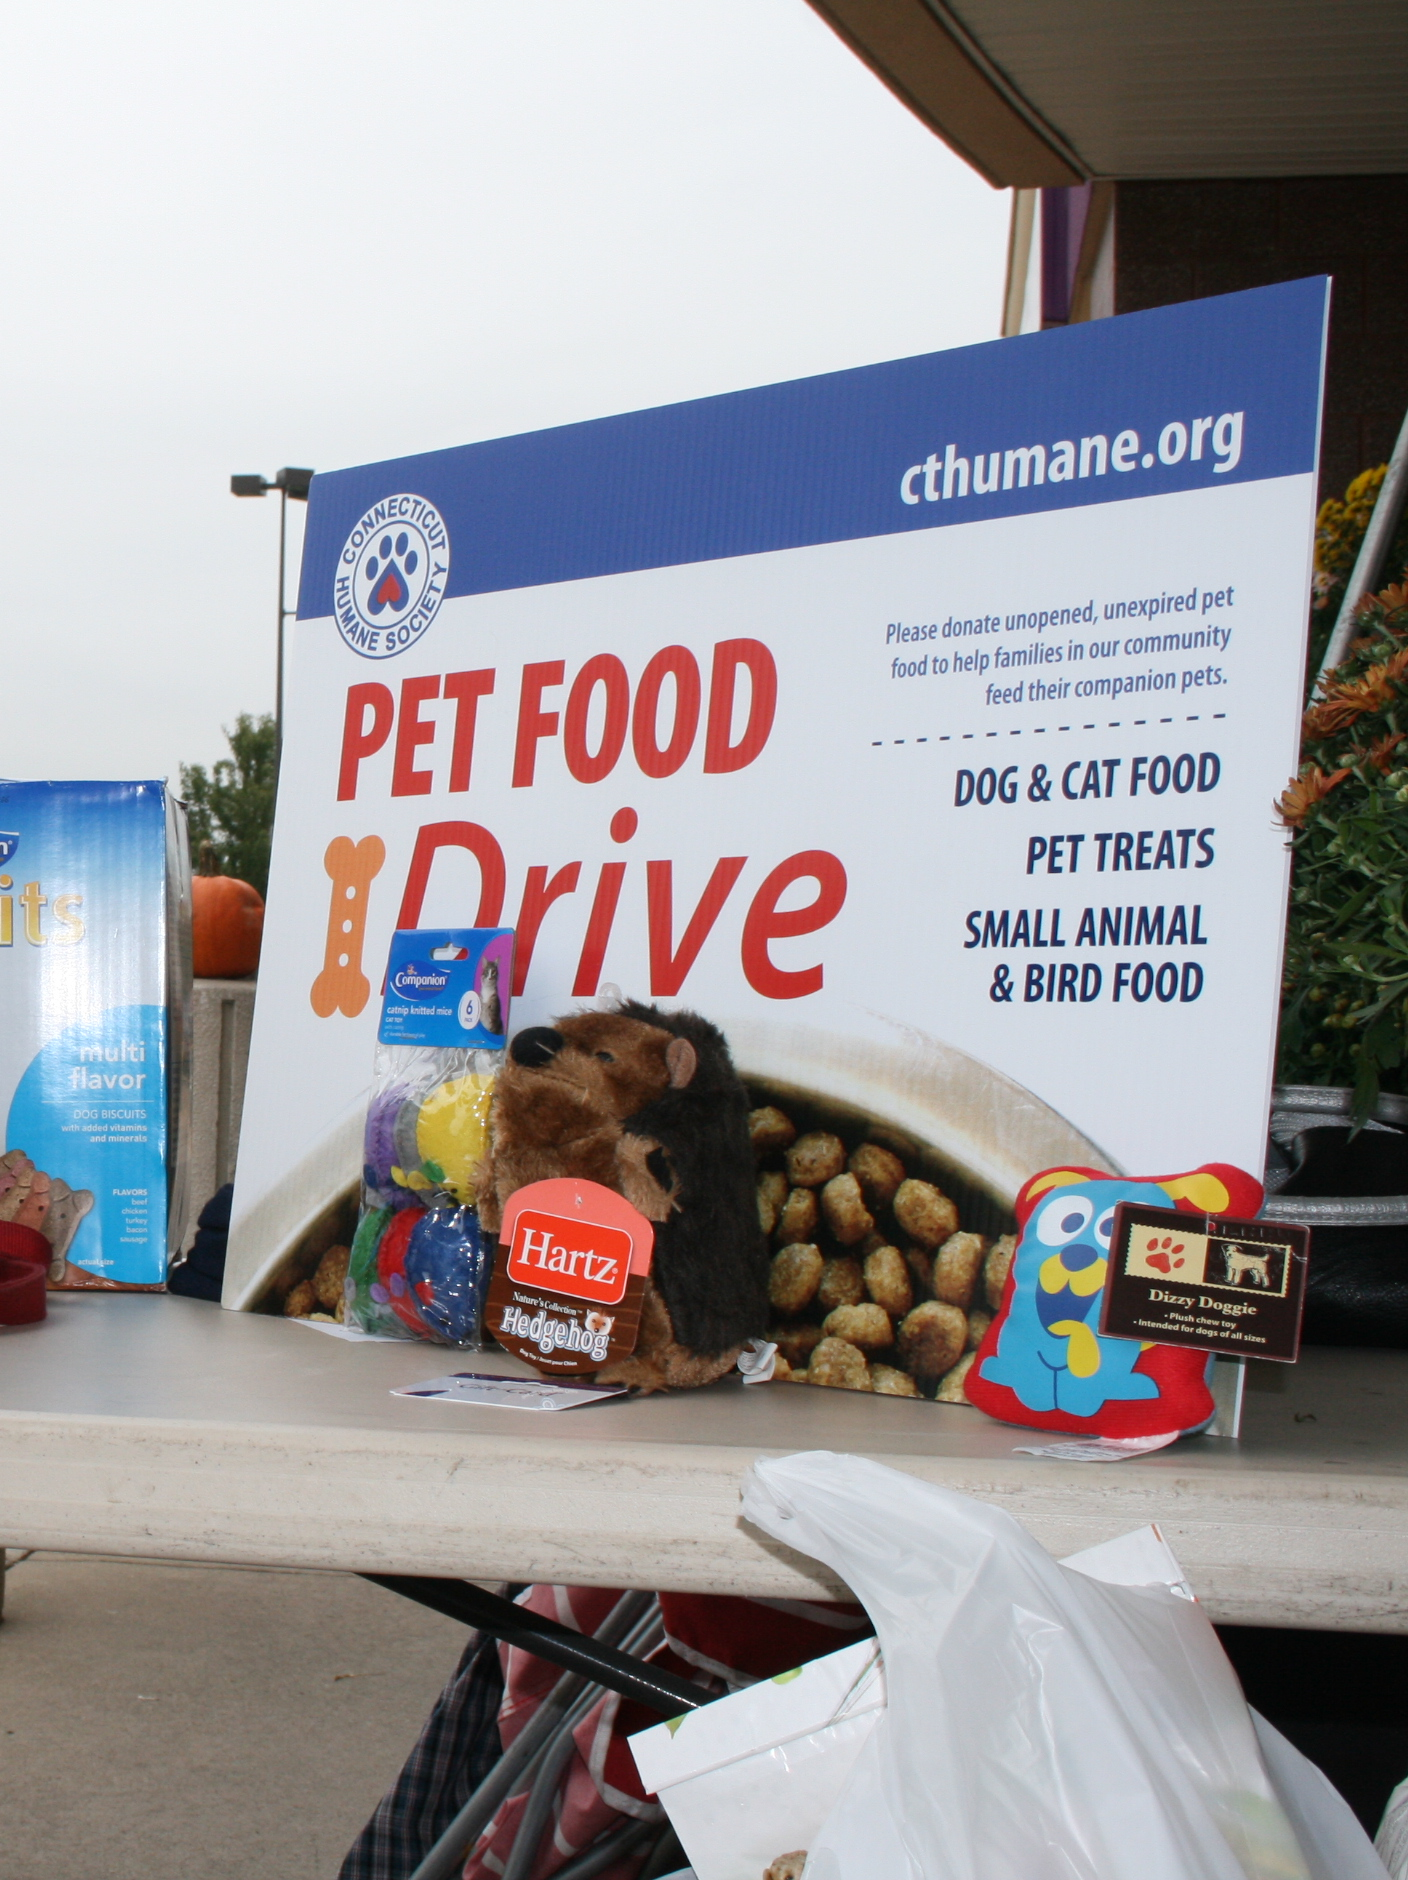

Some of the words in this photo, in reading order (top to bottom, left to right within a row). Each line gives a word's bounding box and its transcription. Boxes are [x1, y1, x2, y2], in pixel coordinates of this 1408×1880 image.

[900, 411, 1244, 505] cthumane.org
[343, 496, 446, 565] CONNECTICUT
[336, 575, 380, 651] HUMANE
[385, 561, 447, 651] SOCIETY
[886, 622, 938, 644] Please
[942, 615, 1000, 638] donate
[1005, 599, 1099, 634] unopened,
[1104, 587, 1198, 621] unexpired
[1201, 586, 1235, 615] pet
[891, 654, 928, 679] food
[932, 655, 949, 674] to
[953, 649, 990, 676] help
[994, 642, 1063, 669] families
[1067, 639, 1084, 662] in
[1089, 640, 1120, 659] our
[1124, 625, 1232, 652] community
[985, 680, 1024, 706] feed
[1028, 677, 1071, 702] their
[1074, 669, 1177, 700] companion
[1181, 665, 1228, 694] pets.
[336, 667, 496, 802] PET
[511, 637, 778, 788] FOOD
[954, 765, 1019, 807] DOG
[1027, 763, 1053, 803] &
[1061, 758, 1121, 800] CAT
[1129, 751, 1222, 797] FOOD
[1026, 834, 1085, 875] PET
[1094, 827, 1216, 872] TREATS
[380, 806, 848, 1000] Drive
[963, 908, 1066, 949] SMALL
[1074, 904, 1208, 947] ANIMAL
[395, 972, 446, 988] Companion
[989, 963, 1014, 1003] &
[1023, 962, 1103, 1003] BIRD
[1112, 961, 1204, 1003] FOOD
[386, 1005, 409, 1017] catnip
[410, 1004, 436, 1016] knitted
[436, 1006, 452, 1016] mice
[466, 1000, 473, 1015] 6
[79, 1039, 146, 1062] multi
[68, 1066, 147, 1090] flavor
[73, 1109, 98, 1119] DOG
[101, 1109, 147, 1119] BISCUITS
[61, 1124, 80, 1132] with
[82, 1124, 108, 1132] added
[110, 1124, 148, 1132] vitamins
[90, 1134, 106, 1142] and
[108, 1134, 148, 1142] minerals
[112, 1188, 148, 1196] FLAVORS
[131, 1198, 148, 1206] beef
[125, 1217, 148, 1226] turkey
[120, 1236, 148, 1244] sausage
[516, 1227, 618, 1285] Hartz
[512, 1291, 544, 1308] Nature's
[544, 1300, 577, 1316] Collection
[1148, 1288, 1195, 1309] Dizzy
[1199, 1296, 1258, 1316] Doggie
[500, 1306, 610, 1362] Hedgehog
[1138, 1318, 1179, 1332] Intended
[1180, 1324, 1195, 1333] for
[1196, 1326, 1218, 1338] dogs
[1220, 1330, 1230, 1338] of
[1230, 1331, 1242, 1340] all
[1244, 1334, 1267, 1344] sizes
[1169, 1312, 1195, 1322] Plush
[1196, 1316, 1219, 1326] chew
[1221, 1320, 1237, 1330] toy
[519, 1348, 529, 1358] Dog
